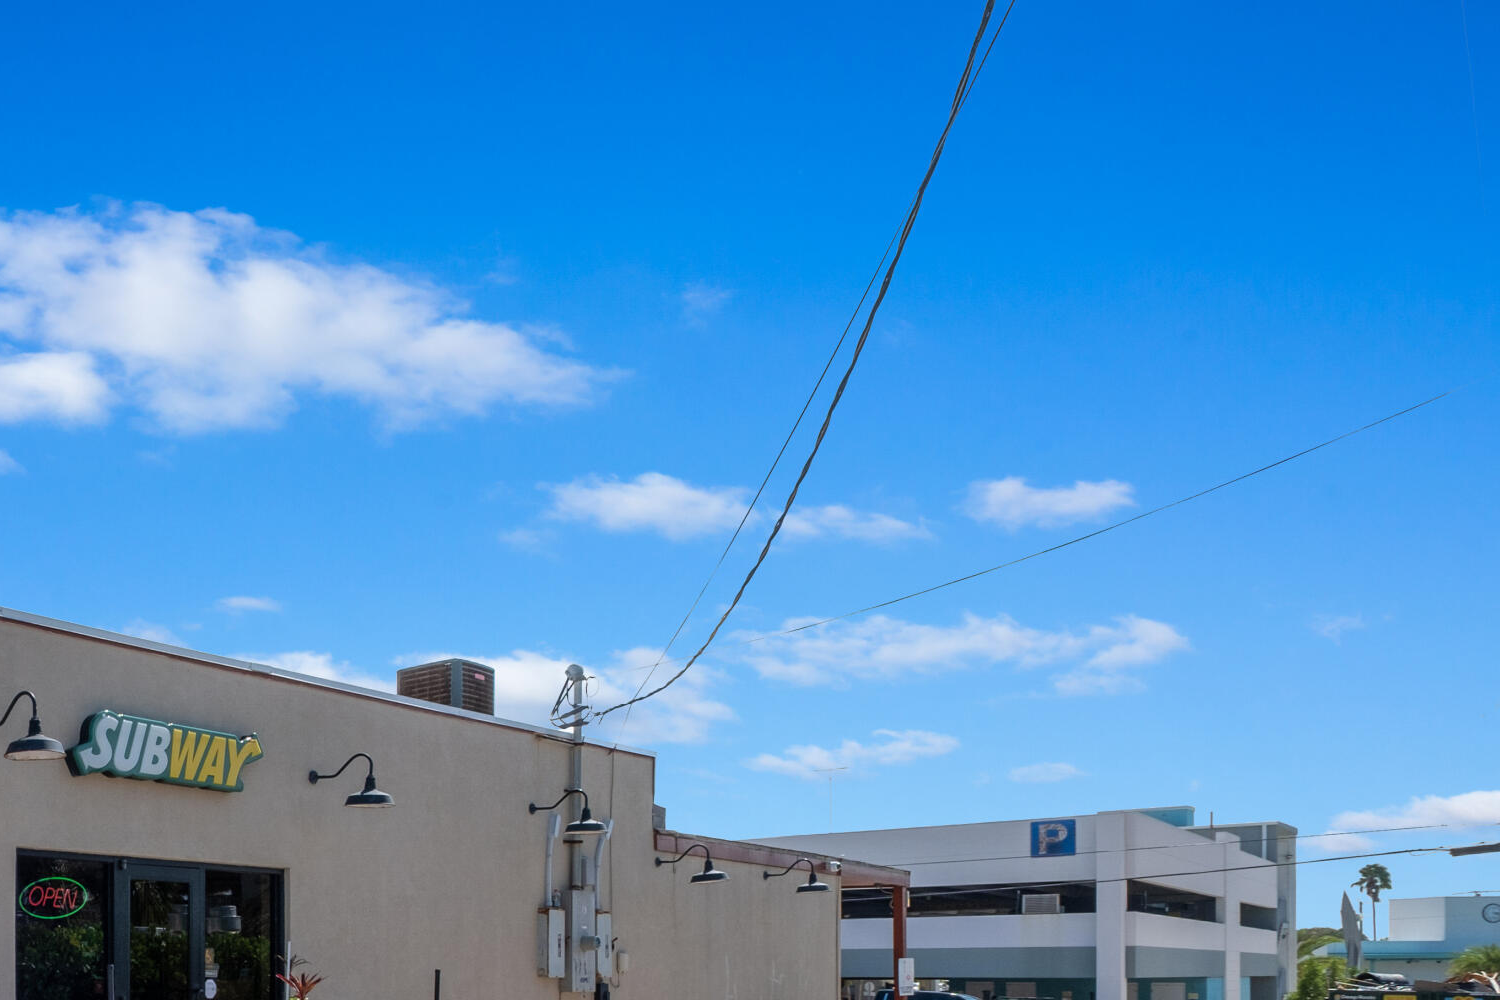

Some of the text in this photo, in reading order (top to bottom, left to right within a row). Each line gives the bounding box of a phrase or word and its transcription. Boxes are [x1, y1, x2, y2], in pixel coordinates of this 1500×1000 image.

[79, 714, 262, 787] SUBWAY
[1038, 823, 1068, 854] P
[28, 885, 78, 910] OPEN
